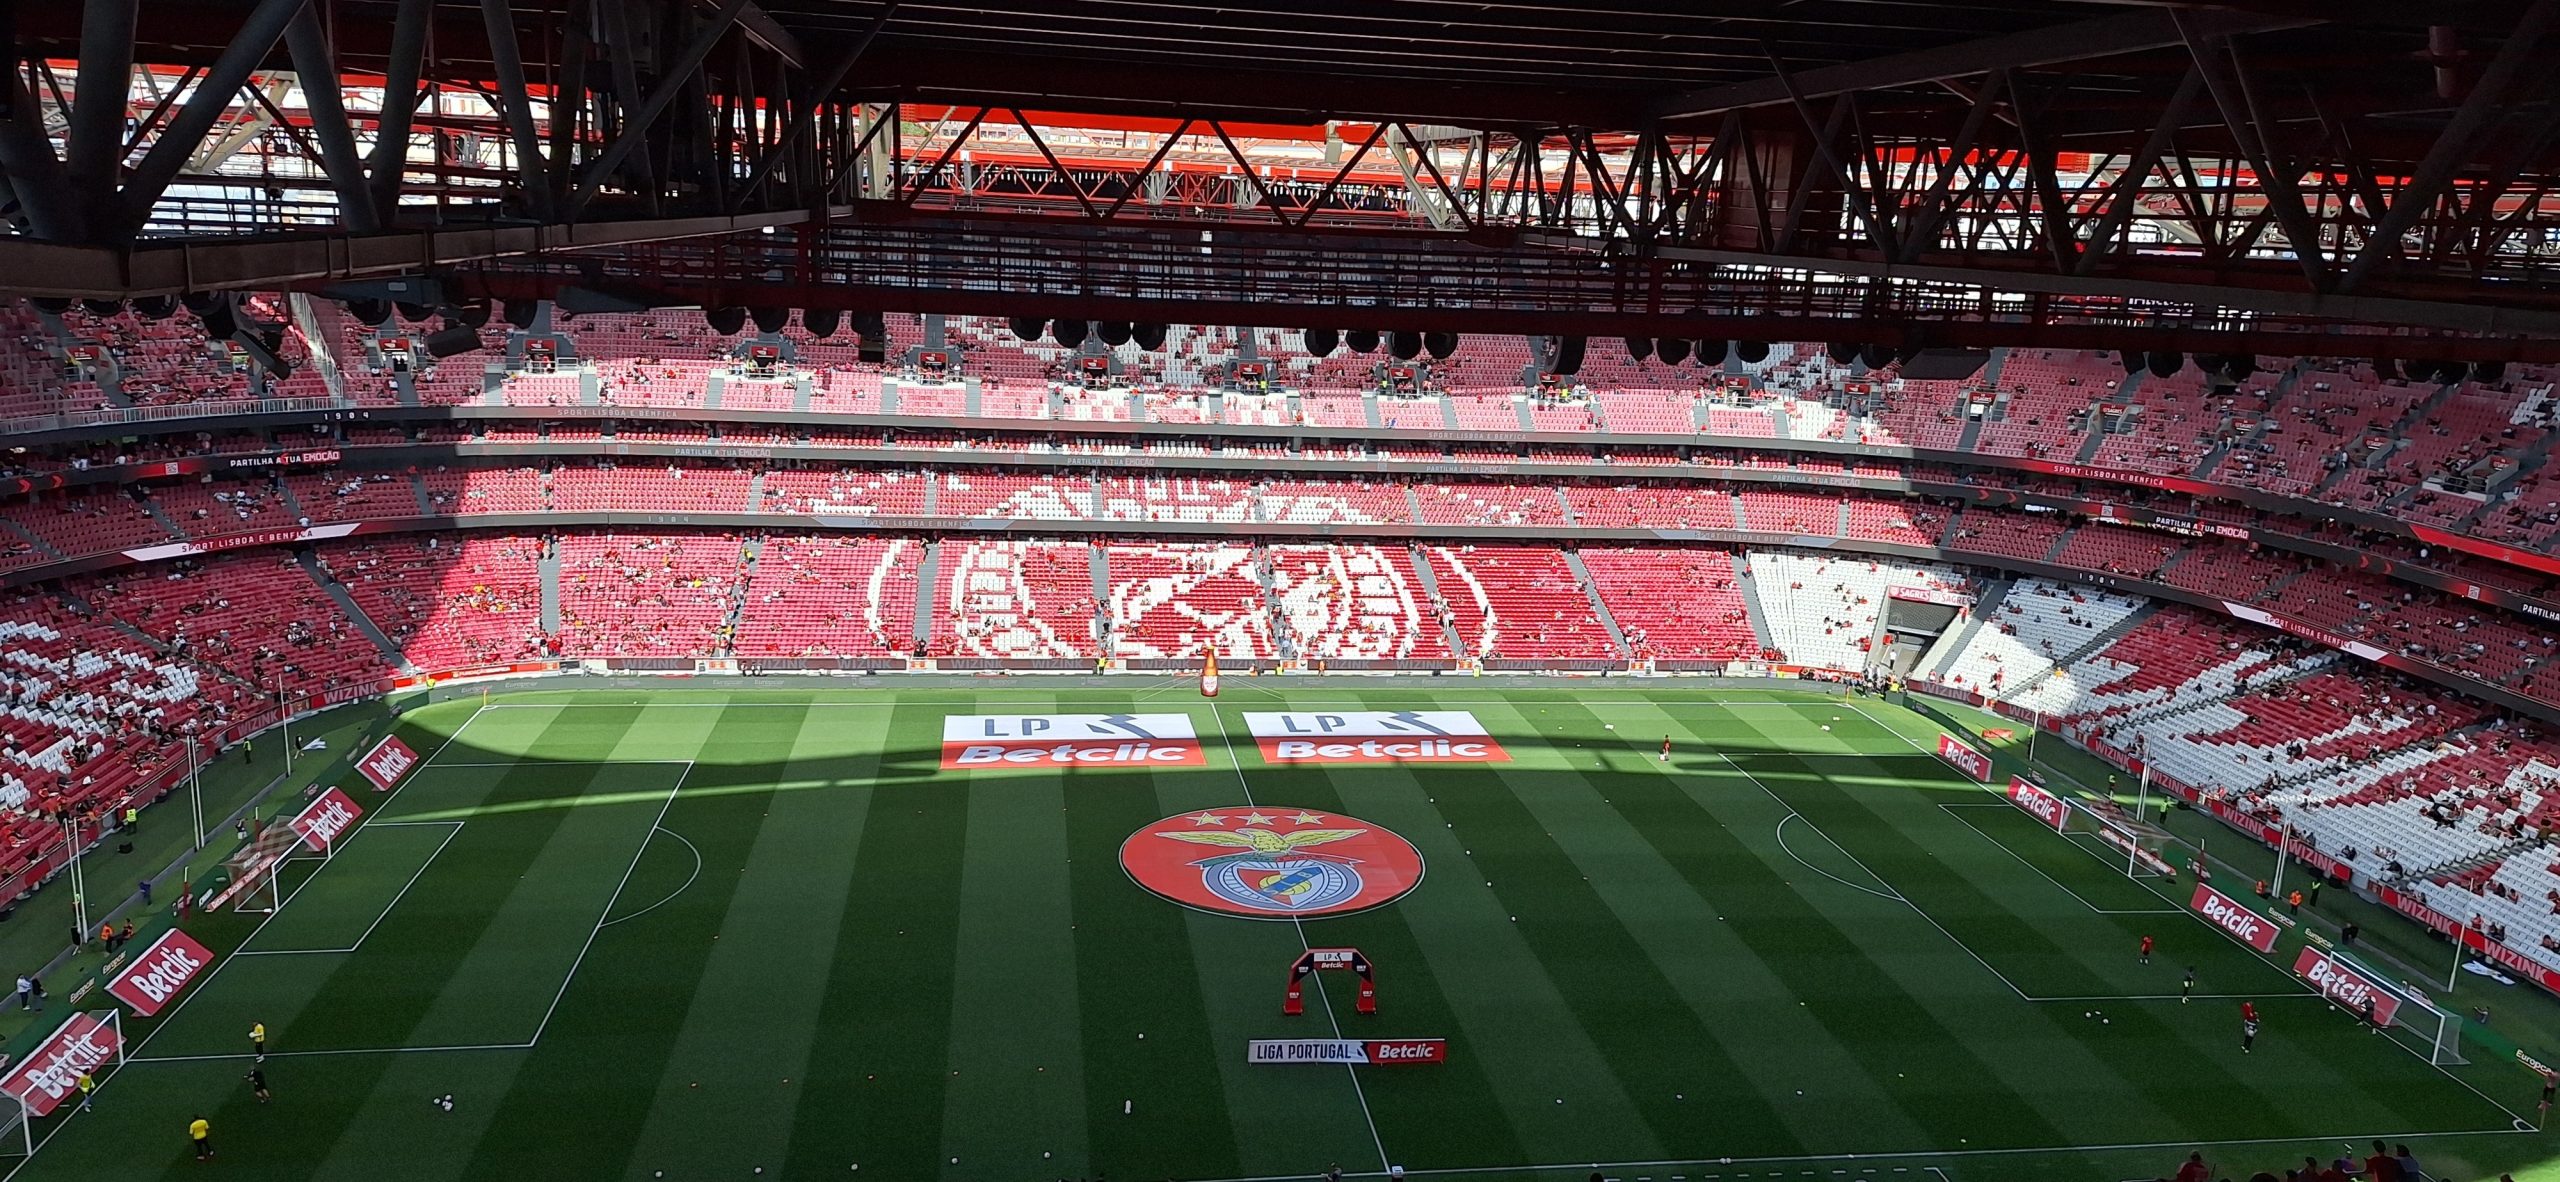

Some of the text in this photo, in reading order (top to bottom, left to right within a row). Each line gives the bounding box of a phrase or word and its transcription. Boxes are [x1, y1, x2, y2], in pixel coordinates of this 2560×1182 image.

[324, 412, 369, 420] 1904
[558, 409, 588, 417] SPORT
[592, 409, 626, 417] LISBOA
[639, 410, 677, 418] BENFICA
[1456, 432, 1483, 440] LISBOA
[230, 457, 273, 467] PARTILHA
[283, 456, 301, 464] TUA
[675, 448, 711, 456] PARTILHA
[2053, 464, 2082, 475] SPORT
[2084, 469, 2117, 480] LISBOA
[2129, 474, 2164, 487] BENFICA
[2155, 517, 2191, 529] PARTILHA
[2199, 524, 2215, 533] TUA
[181, 541, 214, 553] SPORT
[218, 537, 254, 548] LISBOA
[269, 530, 313, 541] BENFICA
[2079, 572, 2115, 586] 1904
[1899, 588, 1930, 601] SAGRES
[1941, 594, 1971, 604] SAGRES
[2522, 603, 2560, 622] PARTILHA
[2264, 615, 2288, 629] SPORT
[2290, 623, 2315, 638] LISBOA
[2323, 634, 2353, 650] BENFICA
[622, 659, 680, 669] WIZINK
[836, 659, 893, 669] WIZINK
[950, 659, 1004, 669] WIZINK
[1030, 659, 1085, 669] WIZINK
[1138, 659, 1192, 669] WIZINK
[1395, 660, 1445, 670] WIZINK
[1496, 660, 1545, 670] WIZINK
[1668, 660, 1716, 670] WIZINK
[323, 682, 380, 705] WIZINK
[1923, 682, 1971, 702] WIZINK
[237, 710, 280, 737] WIZINK
[984, 718, 1050, 736] LP
[1281, 715, 1346, 733] LP
[956, 742, 1188, 764] Betclic
[1277, 739, 1489, 758] Betclic
[2095, 740, 2131, 770] WIZINK
[369, 744, 412, 783] Betclic
[1945, 741, 1981, 776] Betclic
[2016, 782, 2056, 821] Betclic
[305, 798, 354, 842] Betclic
[2222, 805, 2266, 838] WIZINK
[2288, 838, 2337, 876] WIZINK
[2202, 894, 2260, 942] Betclic
[2267, 906, 2296, 927] Europcar
[2397, 894, 2453, 938] WIZINK
[2304, 928, 2334, 949] Europcar
[1321, 961, 1344, 969] Betclic
[2483, 938, 2547, 984] WIZINK
[130, 946, 200, 1003] Betclic
[1257, 1043, 1351, 1060] LIGA PORTUGAL
[1378, 1042, 1434, 1059] Betclic
[24, 1033, 109, 1100] Betclic
[2515, 1049, 2552, 1073] Europca
